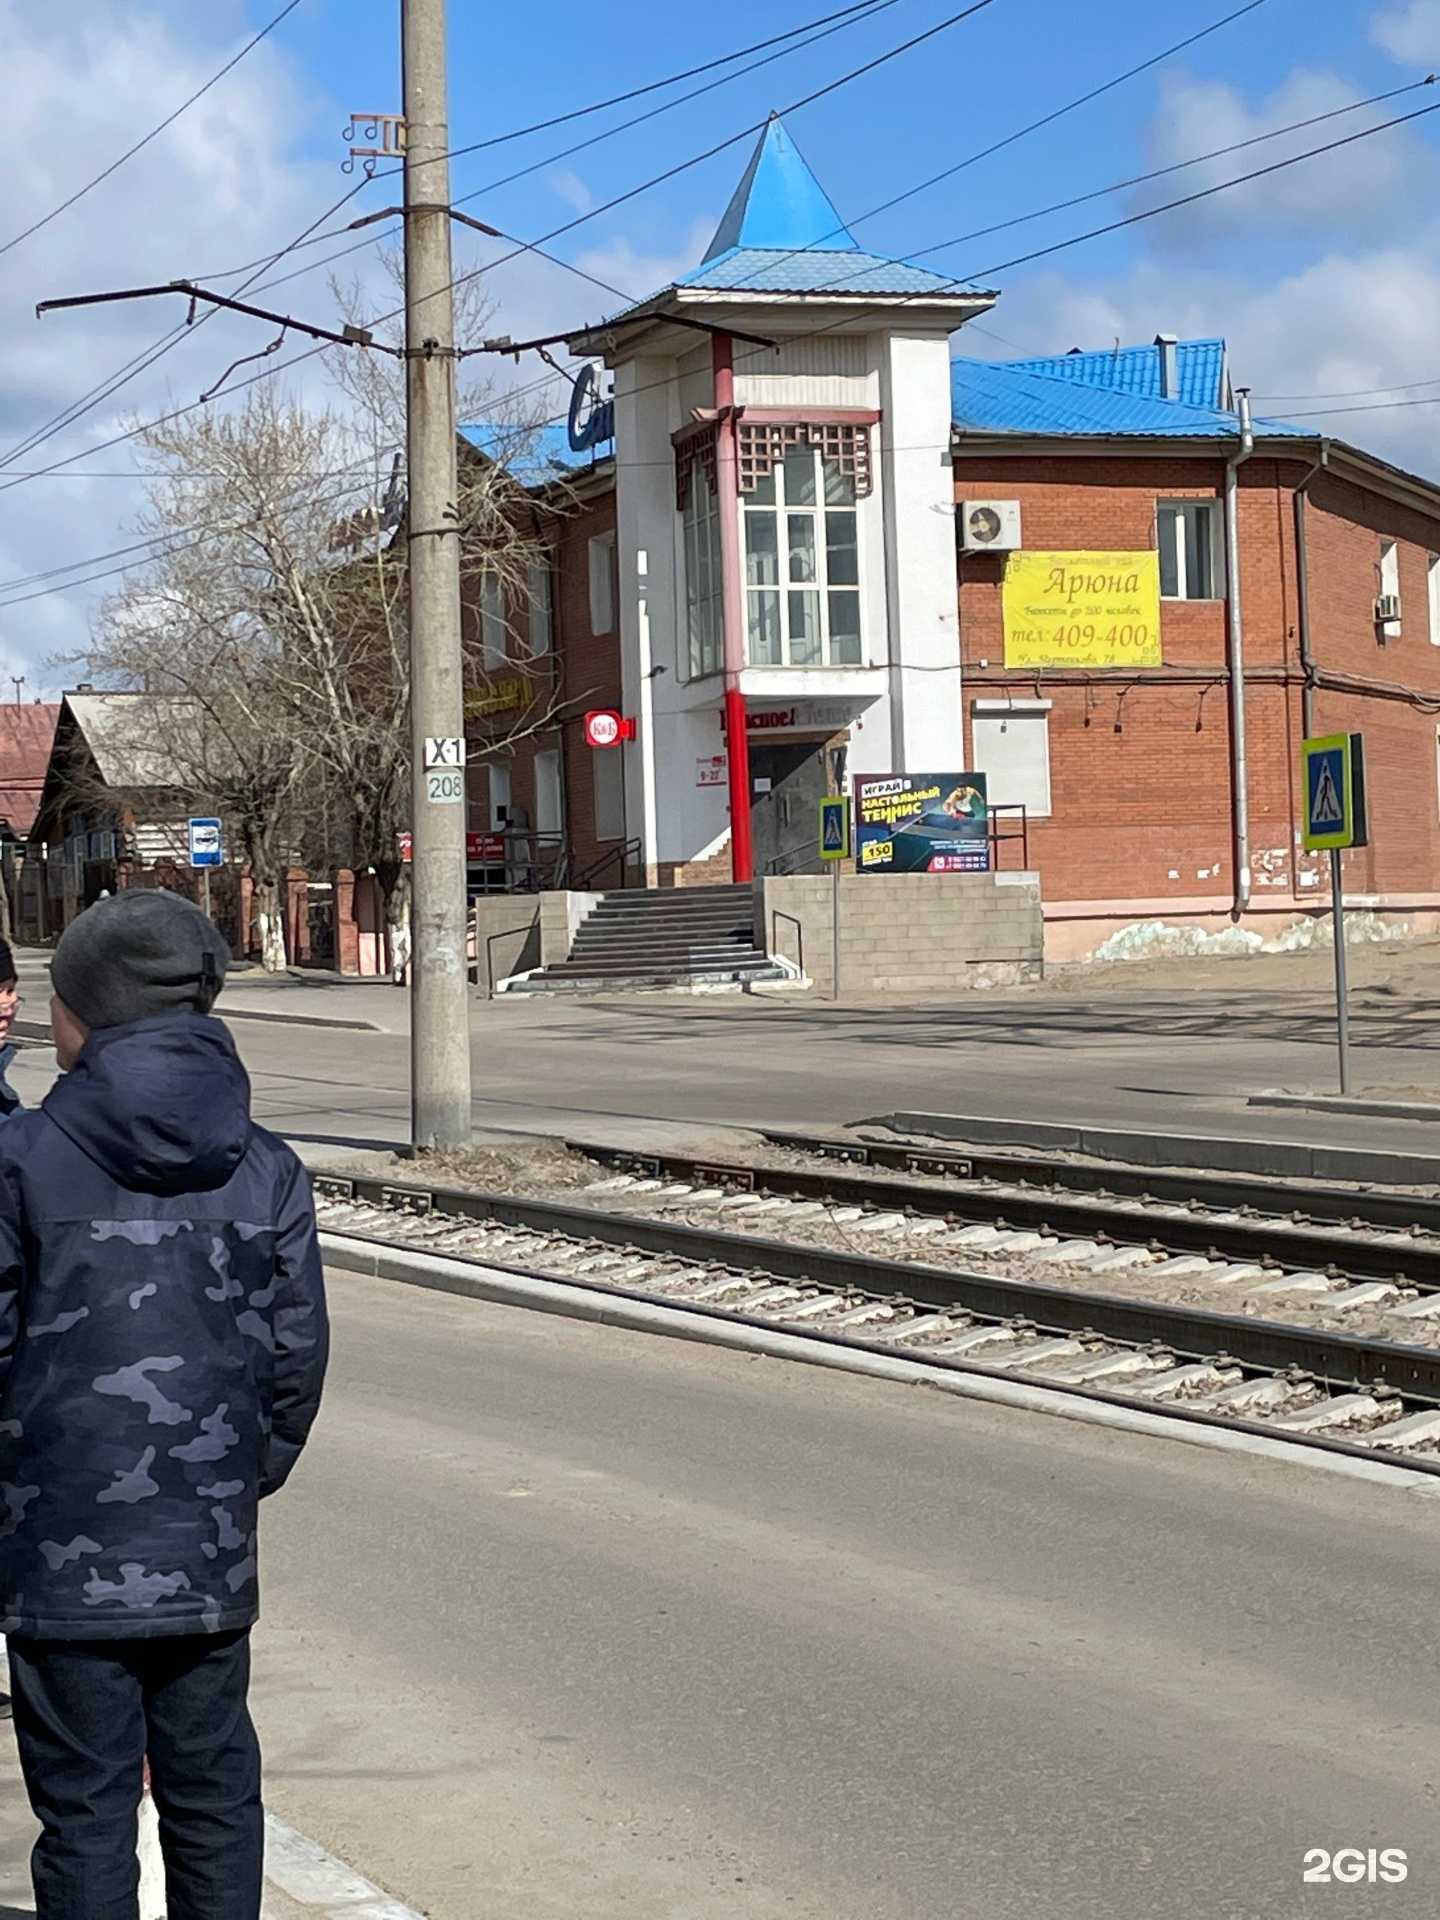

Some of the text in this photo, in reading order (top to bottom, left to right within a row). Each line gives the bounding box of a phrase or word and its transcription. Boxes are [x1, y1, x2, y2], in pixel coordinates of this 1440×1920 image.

[1043, 567, 1140, 603] Арюна
[1053, 624, 1148, 648] 409-400
[429, 775, 462, 799] 208
[861, 802, 922, 824] ТЕННИС
